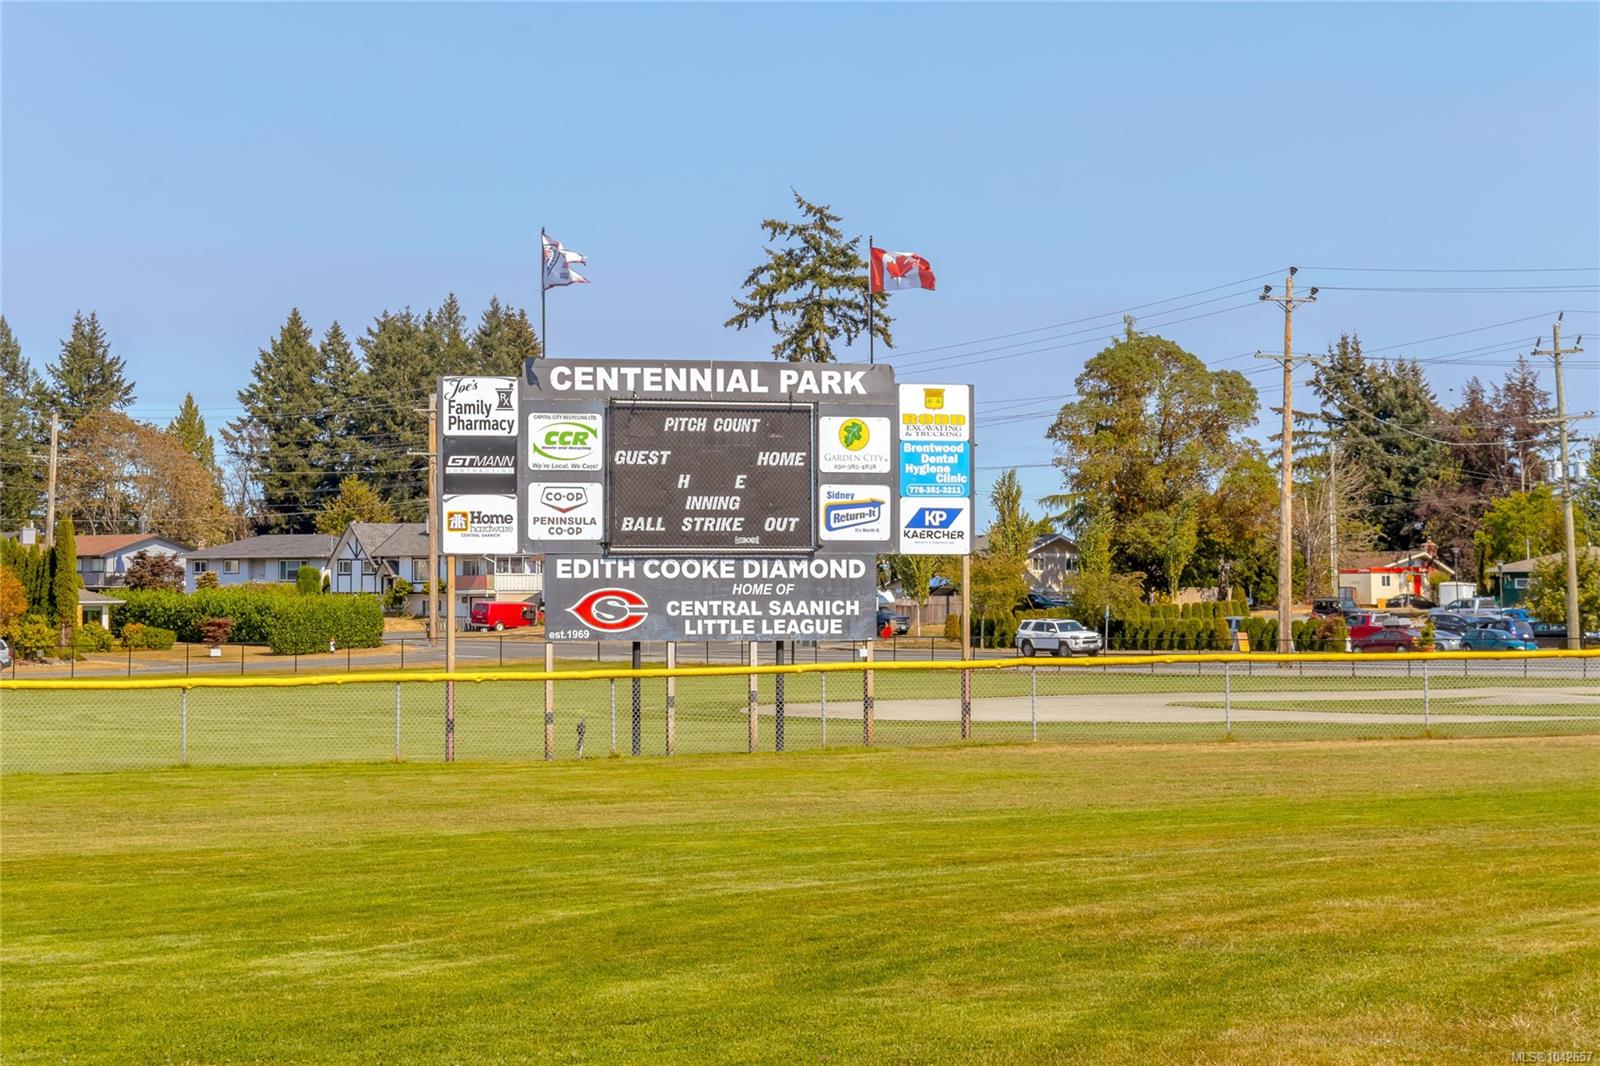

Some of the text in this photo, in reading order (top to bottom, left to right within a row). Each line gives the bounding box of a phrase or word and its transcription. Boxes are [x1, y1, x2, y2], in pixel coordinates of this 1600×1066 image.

[550, 366, 867, 395] CENTENNIAL PARK
[444, 378, 478, 400] Joe's
[448, 400, 492, 418] Family
[448, 416, 515, 434] Pharmacy
[664, 417, 761, 433] PITCH COUNT
[544, 431, 589, 445] CCR
[904, 443, 964, 453] Brentwood
[614, 450, 671, 465] GUEST
[757, 452, 806, 466] HOME
[921, 454, 958, 464] Dental
[905, 463, 950, 475] Hygiene
[678, 474, 690, 489] H
[735, 475, 747, 489] E
[936, 473, 967, 483] Clinic
[827, 491, 855, 500] Sidney
[685, 496, 741, 510] INNING
[470, 511, 513, 524] Home
[533, 517, 597, 526] PENINSULA
[833, 506, 877, 524] Return-It
[924, 511, 947, 526] KP
[470, 524, 513, 533] hardware
[621, 517, 799, 531] BALL STRIKE OUT
[904, 530, 964, 540] KAERCHER
[556, 559, 866, 579] EDITH COOKE DIAMOND
[732, 584, 795, 595] HOME OF
[666, 600, 860, 616] CENTRAL SAANICH
[685, 619, 843, 635] LITTLE LEAGUE
[549, 630, 590, 640] est.1969
